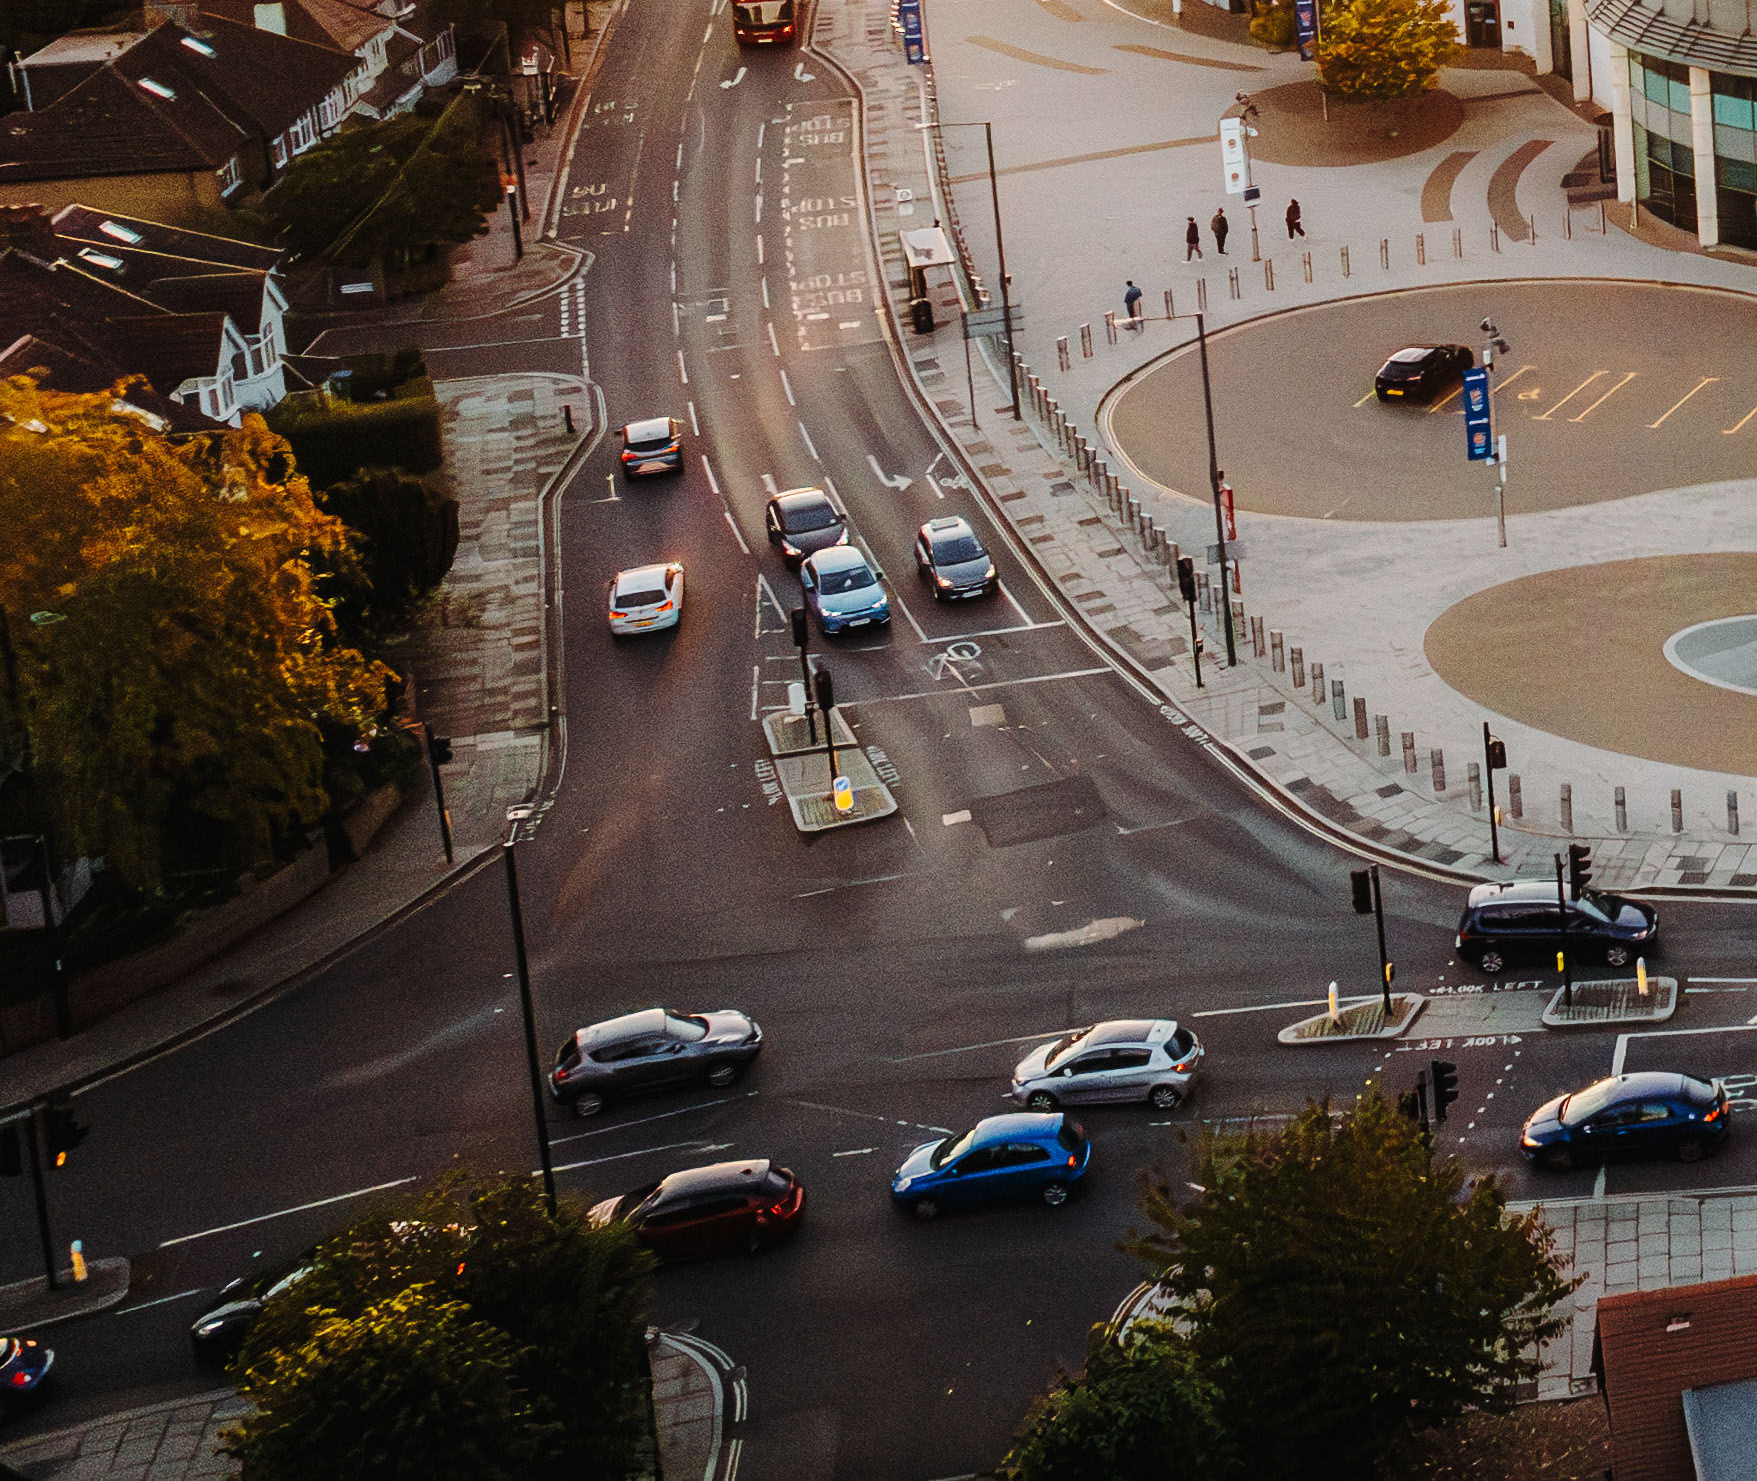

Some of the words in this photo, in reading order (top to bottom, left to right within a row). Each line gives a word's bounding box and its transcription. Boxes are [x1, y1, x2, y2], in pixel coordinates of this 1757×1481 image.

[1493, 980, 1543, 992] LEFT
[1395, 1038, 1453, 1052] LEFT
[1462, 1035, 1507, 1048] LOOK
